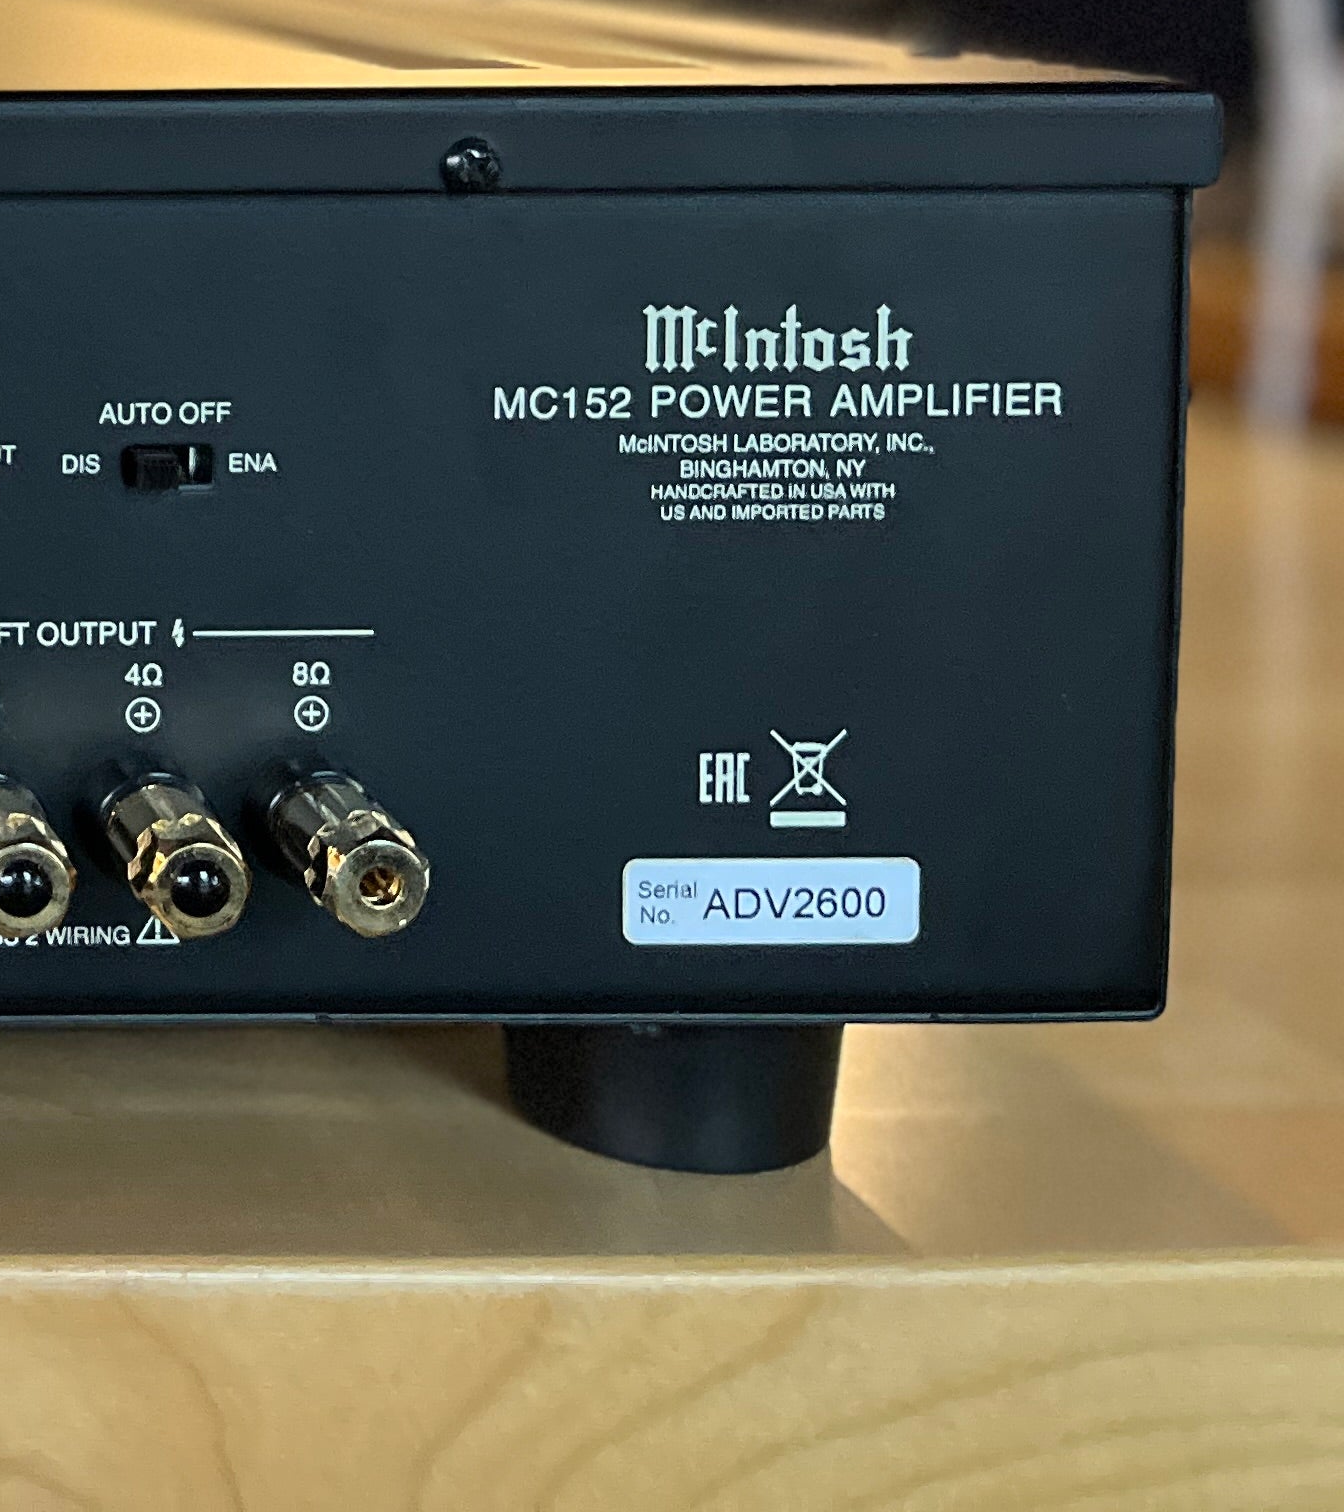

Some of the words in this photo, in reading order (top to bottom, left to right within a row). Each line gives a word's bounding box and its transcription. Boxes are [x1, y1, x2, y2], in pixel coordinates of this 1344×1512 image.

[643, 304, 913, 373] McIntosh
[494, 386, 631, 420] MC152
[652, 384, 810, 418] POWER
[830, 383, 1061, 417] AMPLIFIER
[99, 402, 172, 425] AUTO
[179, 402, 231, 424] OFF
[619, 434, 727, 453] McINTOSH
[734, 433, 880, 455] LABORATORY,
[62, 454, 100, 474] DIS
[229, 453, 276, 472] ENA
[681, 459, 829, 479] BINGHAMTON,
[837, 459, 866, 479] NY
[651, 483, 784, 500] HANDCRAFTED
[811, 483, 846, 499] USA
[850, 483, 896, 499] WITH
[661, 504, 685, 520] US
[690, 505, 726, 520] AND
[732, 504, 823, 520] IMPORTED
[828, 503, 885, 520] PARTS
[37, 621, 157, 646] OUTPUT
[125, 663, 162, 687] 4Ω
[293, 662, 329, 686] 8Ω
[639, 881, 696, 898] Serial
[703, 887, 885, 920] ADV2600
[641, 906, 673, 924] No.
[46, 926, 130, 946] WIRING
